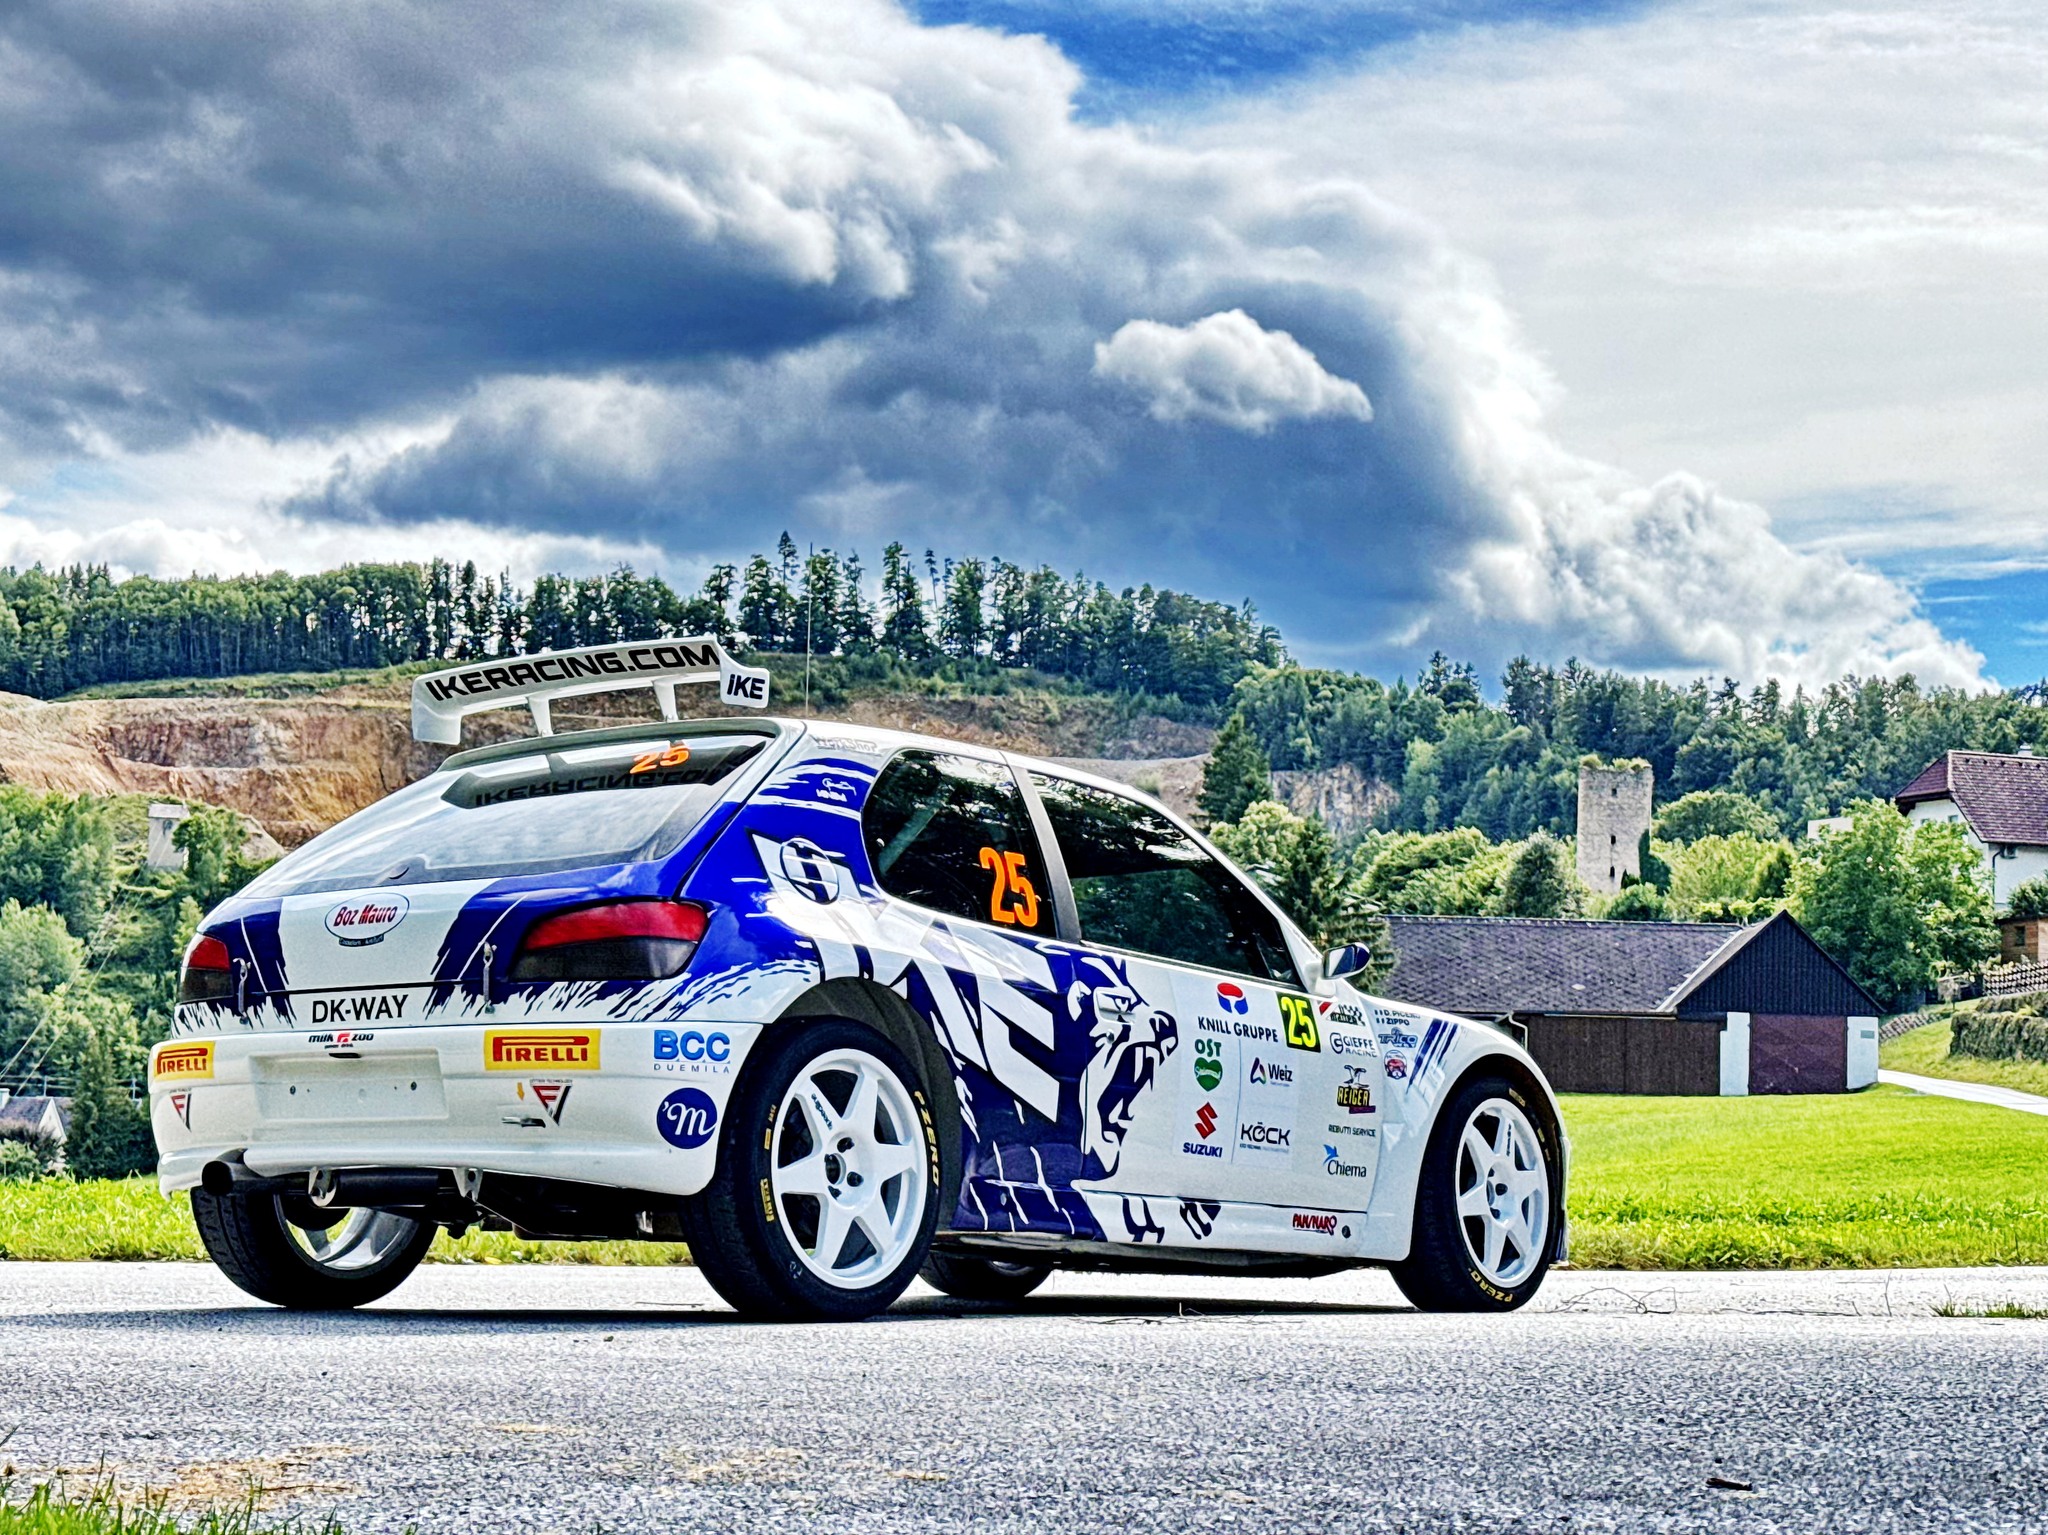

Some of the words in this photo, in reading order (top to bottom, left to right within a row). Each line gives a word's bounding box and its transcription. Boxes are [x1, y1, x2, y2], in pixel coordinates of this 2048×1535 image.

[426, 645, 720, 701] IKERACING.COM
[727, 674, 765, 700] IKE
[630, 744, 690, 774] 25
[979, 846, 1038, 927] 25
[333, 906, 359, 927] Boz
[358, 904, 398, 924] Mauro
[312, 994, 409, 1023] DK-WAY
[1198, 1016, 1231, 1035] KNILL
[1233, 1022, 1278, 1042] GRUPPE
[1281, 996, 1316, 1048] 25
[492, 1036, 590, 1062] PIRELLI
[654, 1030, 730, 1061] BCC
[1194, 1038, 1222, 1057] OST
[157, 1047, 208, 1074] PIRELLI
[654, 1063, 730, 1074] DUEMILA
[1268, 1063, 1293, 1082] Weiz
[1240, 1121, 1291, 1146] KÖCK
[1352, 1127, 1376, 1137] SERVICE
[1182, 1142, 1223, 1158] SUZUKI
[1327, 1159, 1367, 1178] Chiema
